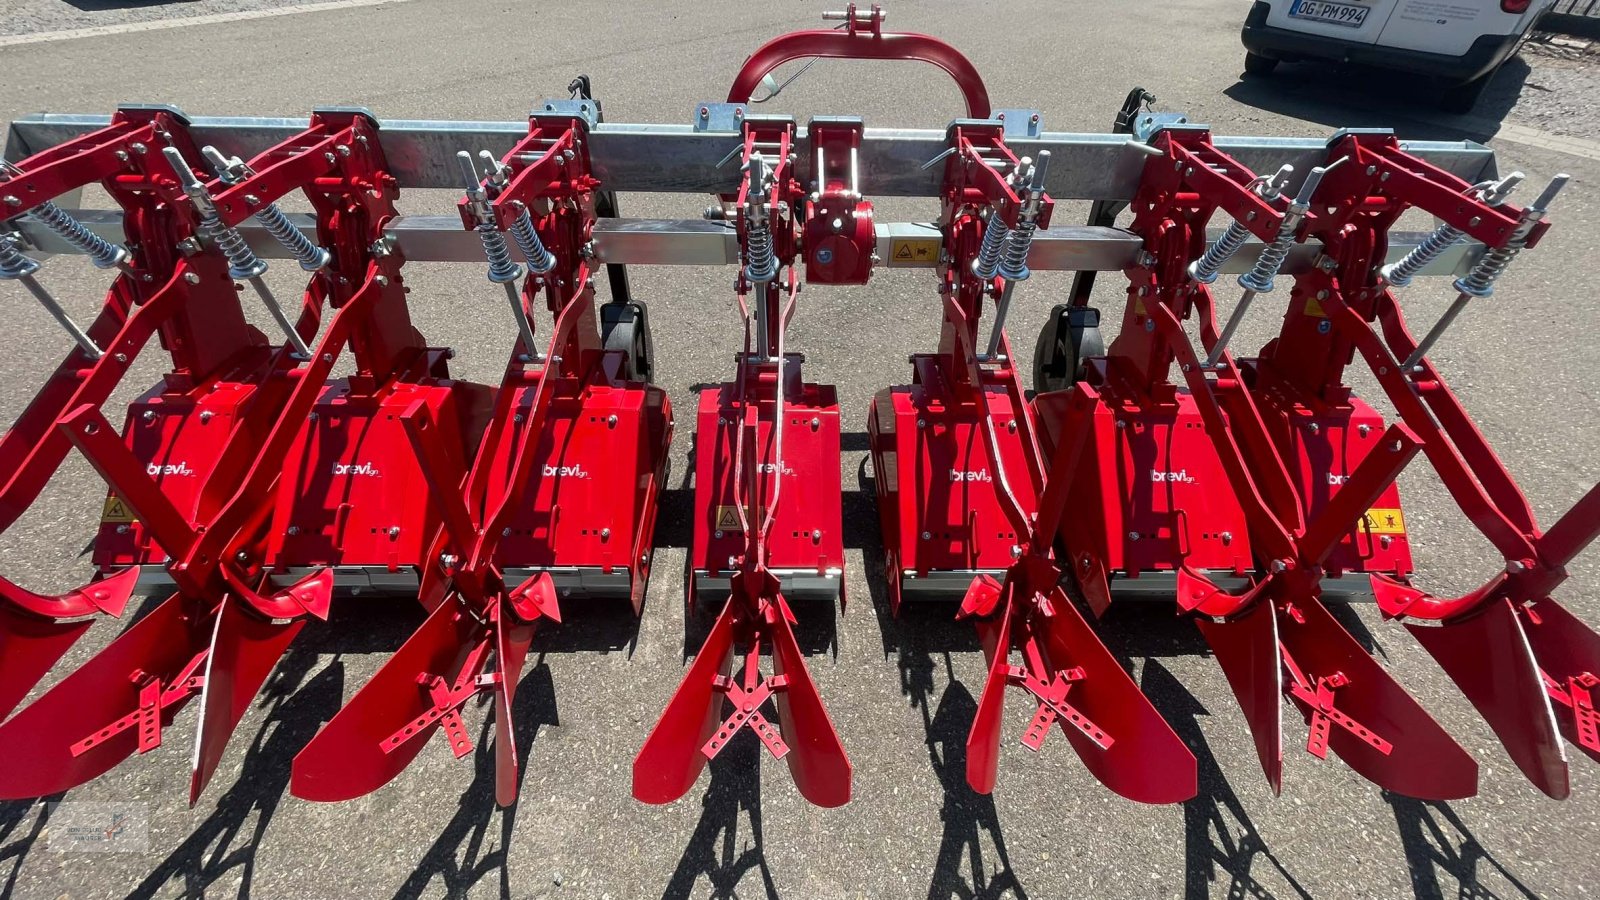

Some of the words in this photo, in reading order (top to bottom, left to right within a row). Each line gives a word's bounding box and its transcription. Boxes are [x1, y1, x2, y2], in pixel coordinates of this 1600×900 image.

[1298, 2, 1316, 14] OG
[1321, 5, 1340, 18] PM
[1339, 7, 1365, 22] 994
[147, 461, 186, 475] brevi
[333, 462, 372, 475] brevi
[542, 464, 580, 476] brevi
[949, 468, 986, 481] brevi
[1151, 469, 1186, 482] brevi
